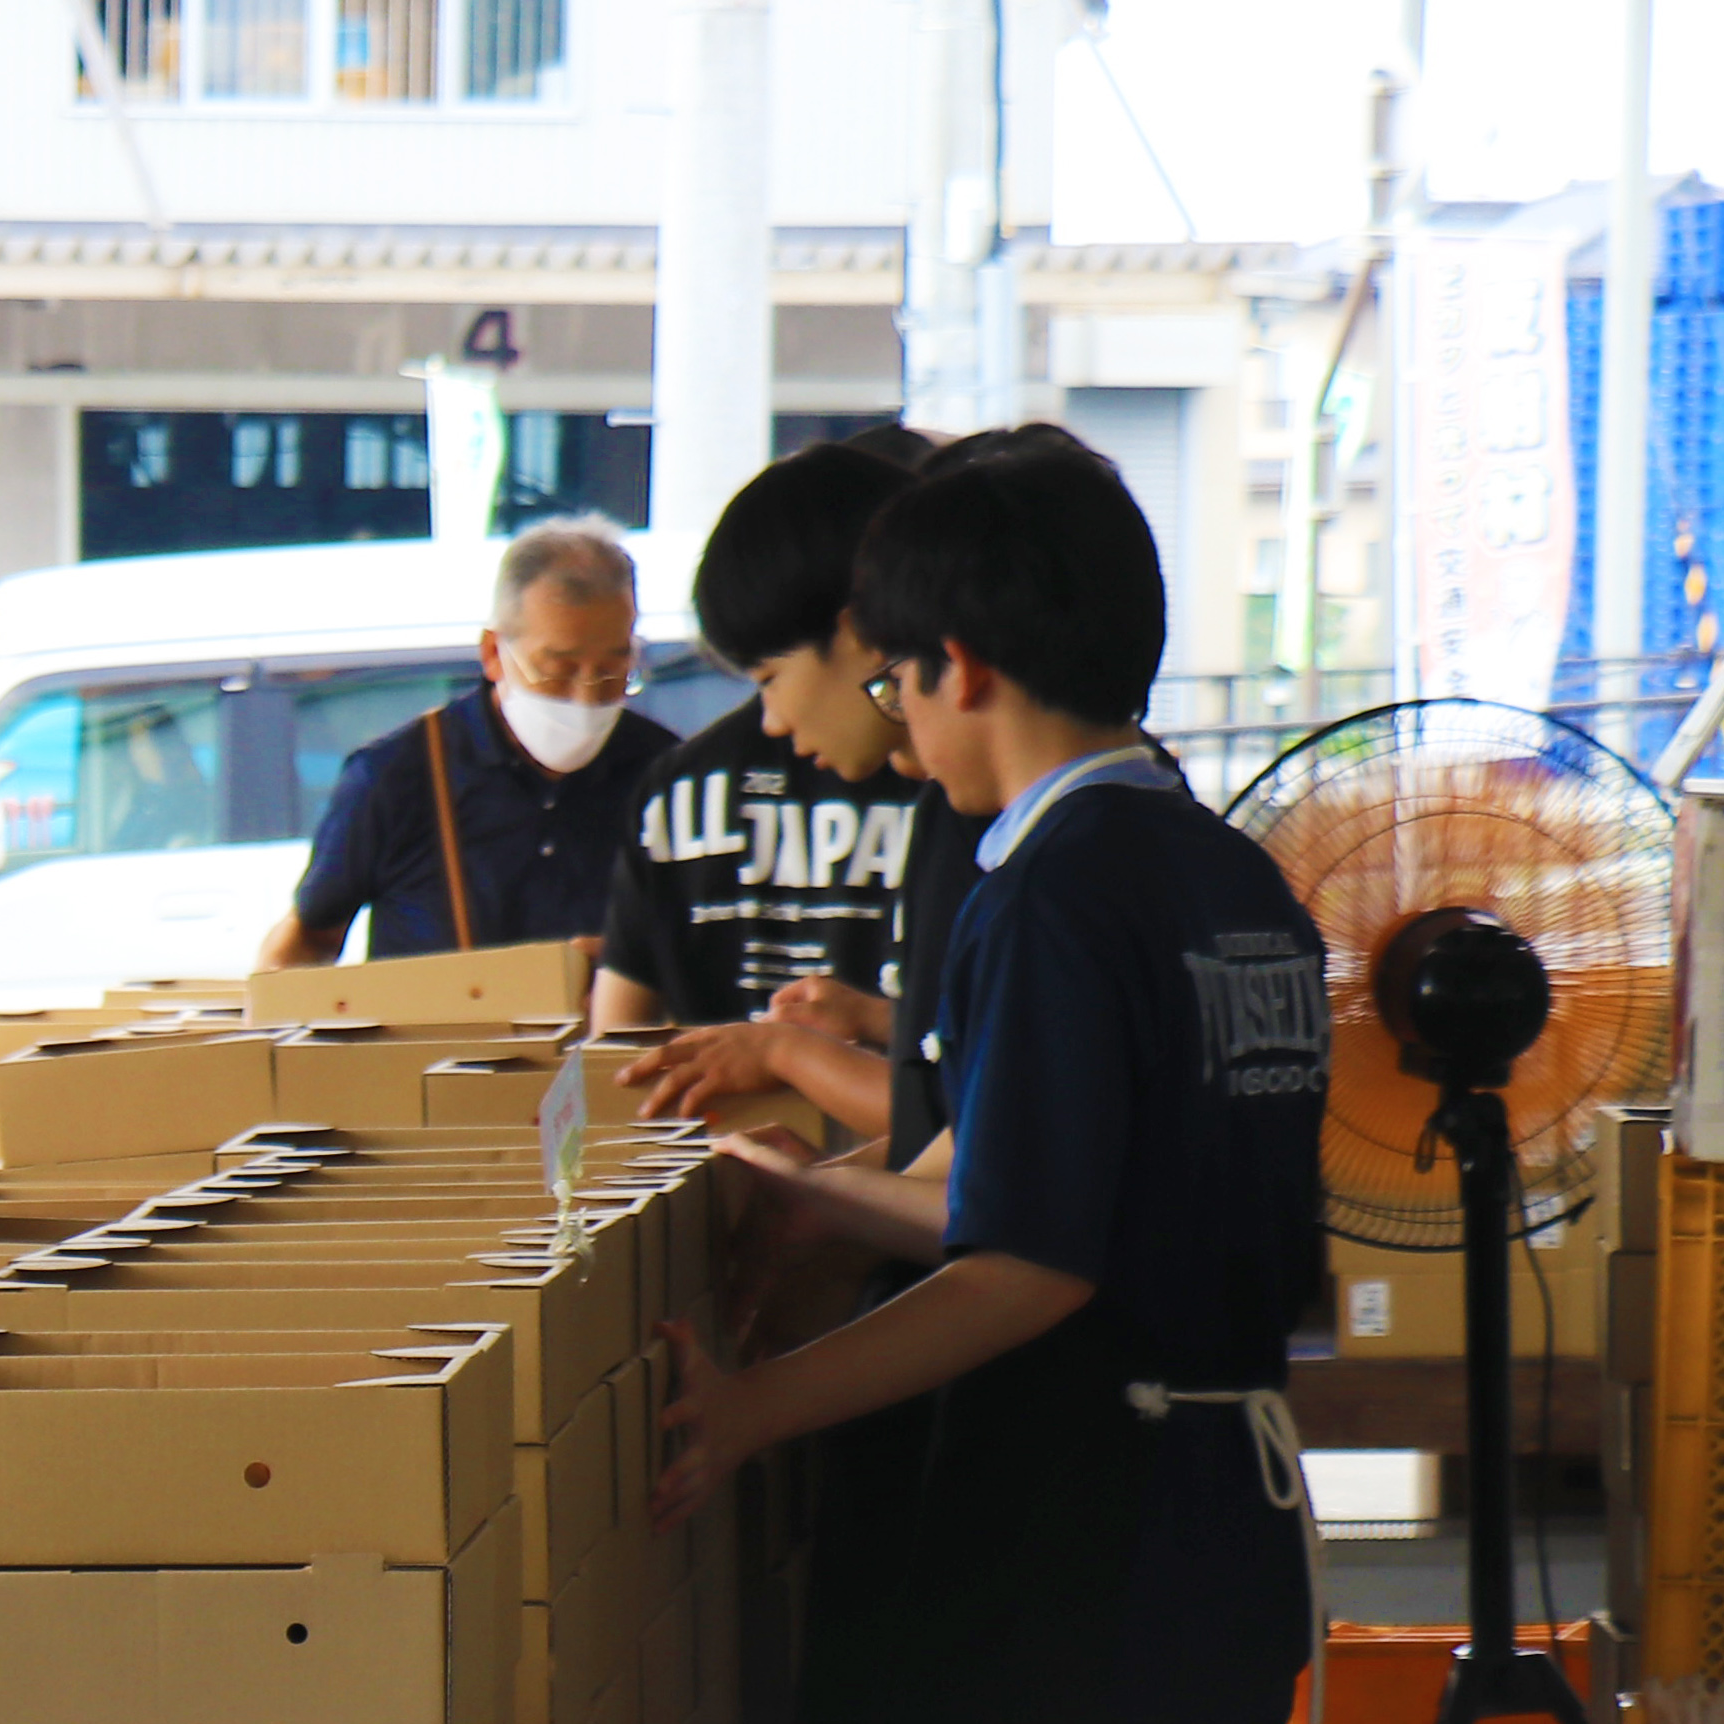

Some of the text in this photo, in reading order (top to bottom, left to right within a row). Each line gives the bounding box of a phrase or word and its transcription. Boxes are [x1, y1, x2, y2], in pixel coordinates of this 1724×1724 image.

[462, 310, 519, 371] 4
[640, 771, 917, 890] ALL JAPA
